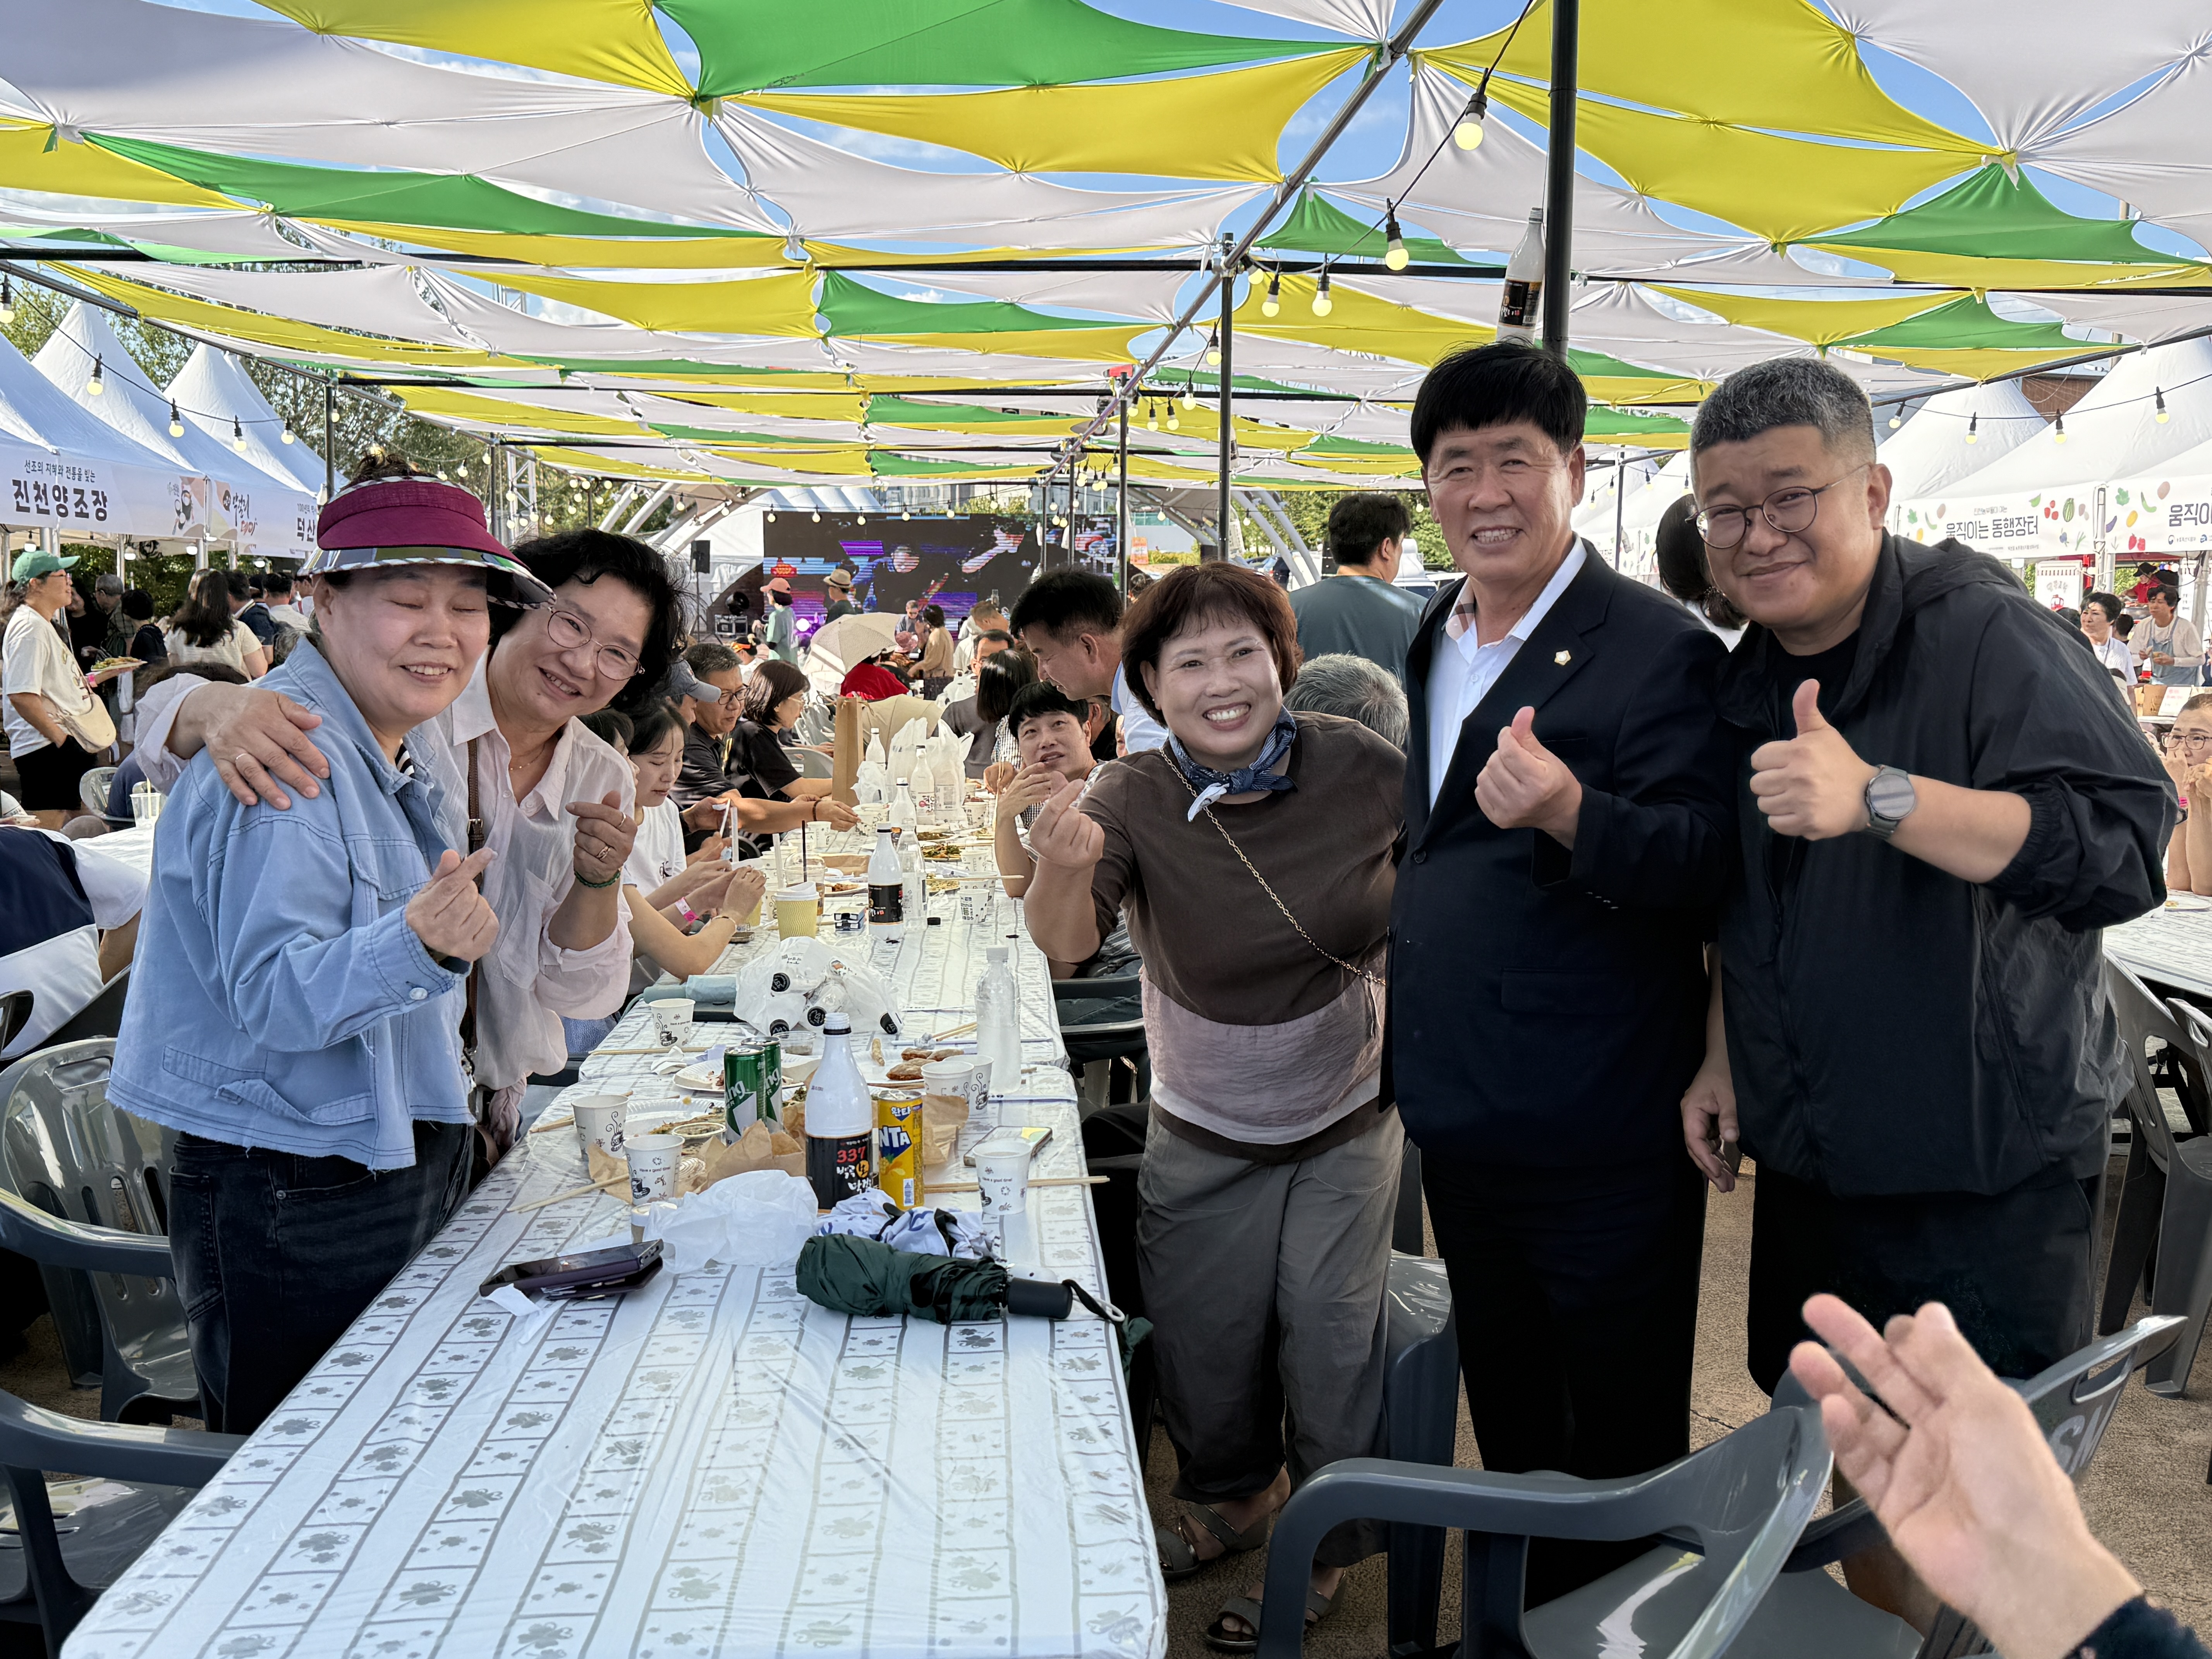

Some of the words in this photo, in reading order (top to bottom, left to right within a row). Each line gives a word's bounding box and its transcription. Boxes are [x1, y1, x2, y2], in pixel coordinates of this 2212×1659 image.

[24, 460, 43, 474] 선조의
[46, 463, 63, 477] 지혜와
[66, 466, 82, 482] 전통을
[84, 469, 95, 483] 빚는
[12, 479, 107, 521] 진천양조장
[297, 517, 315, 542] 덕산
[1946, 521, 1989, 540] 움직이는
[1992, 515, 2038, 538] 동행장터
[891, 1106, 911, 1116] 환타
[836, 1146, 866, 1163] 337
